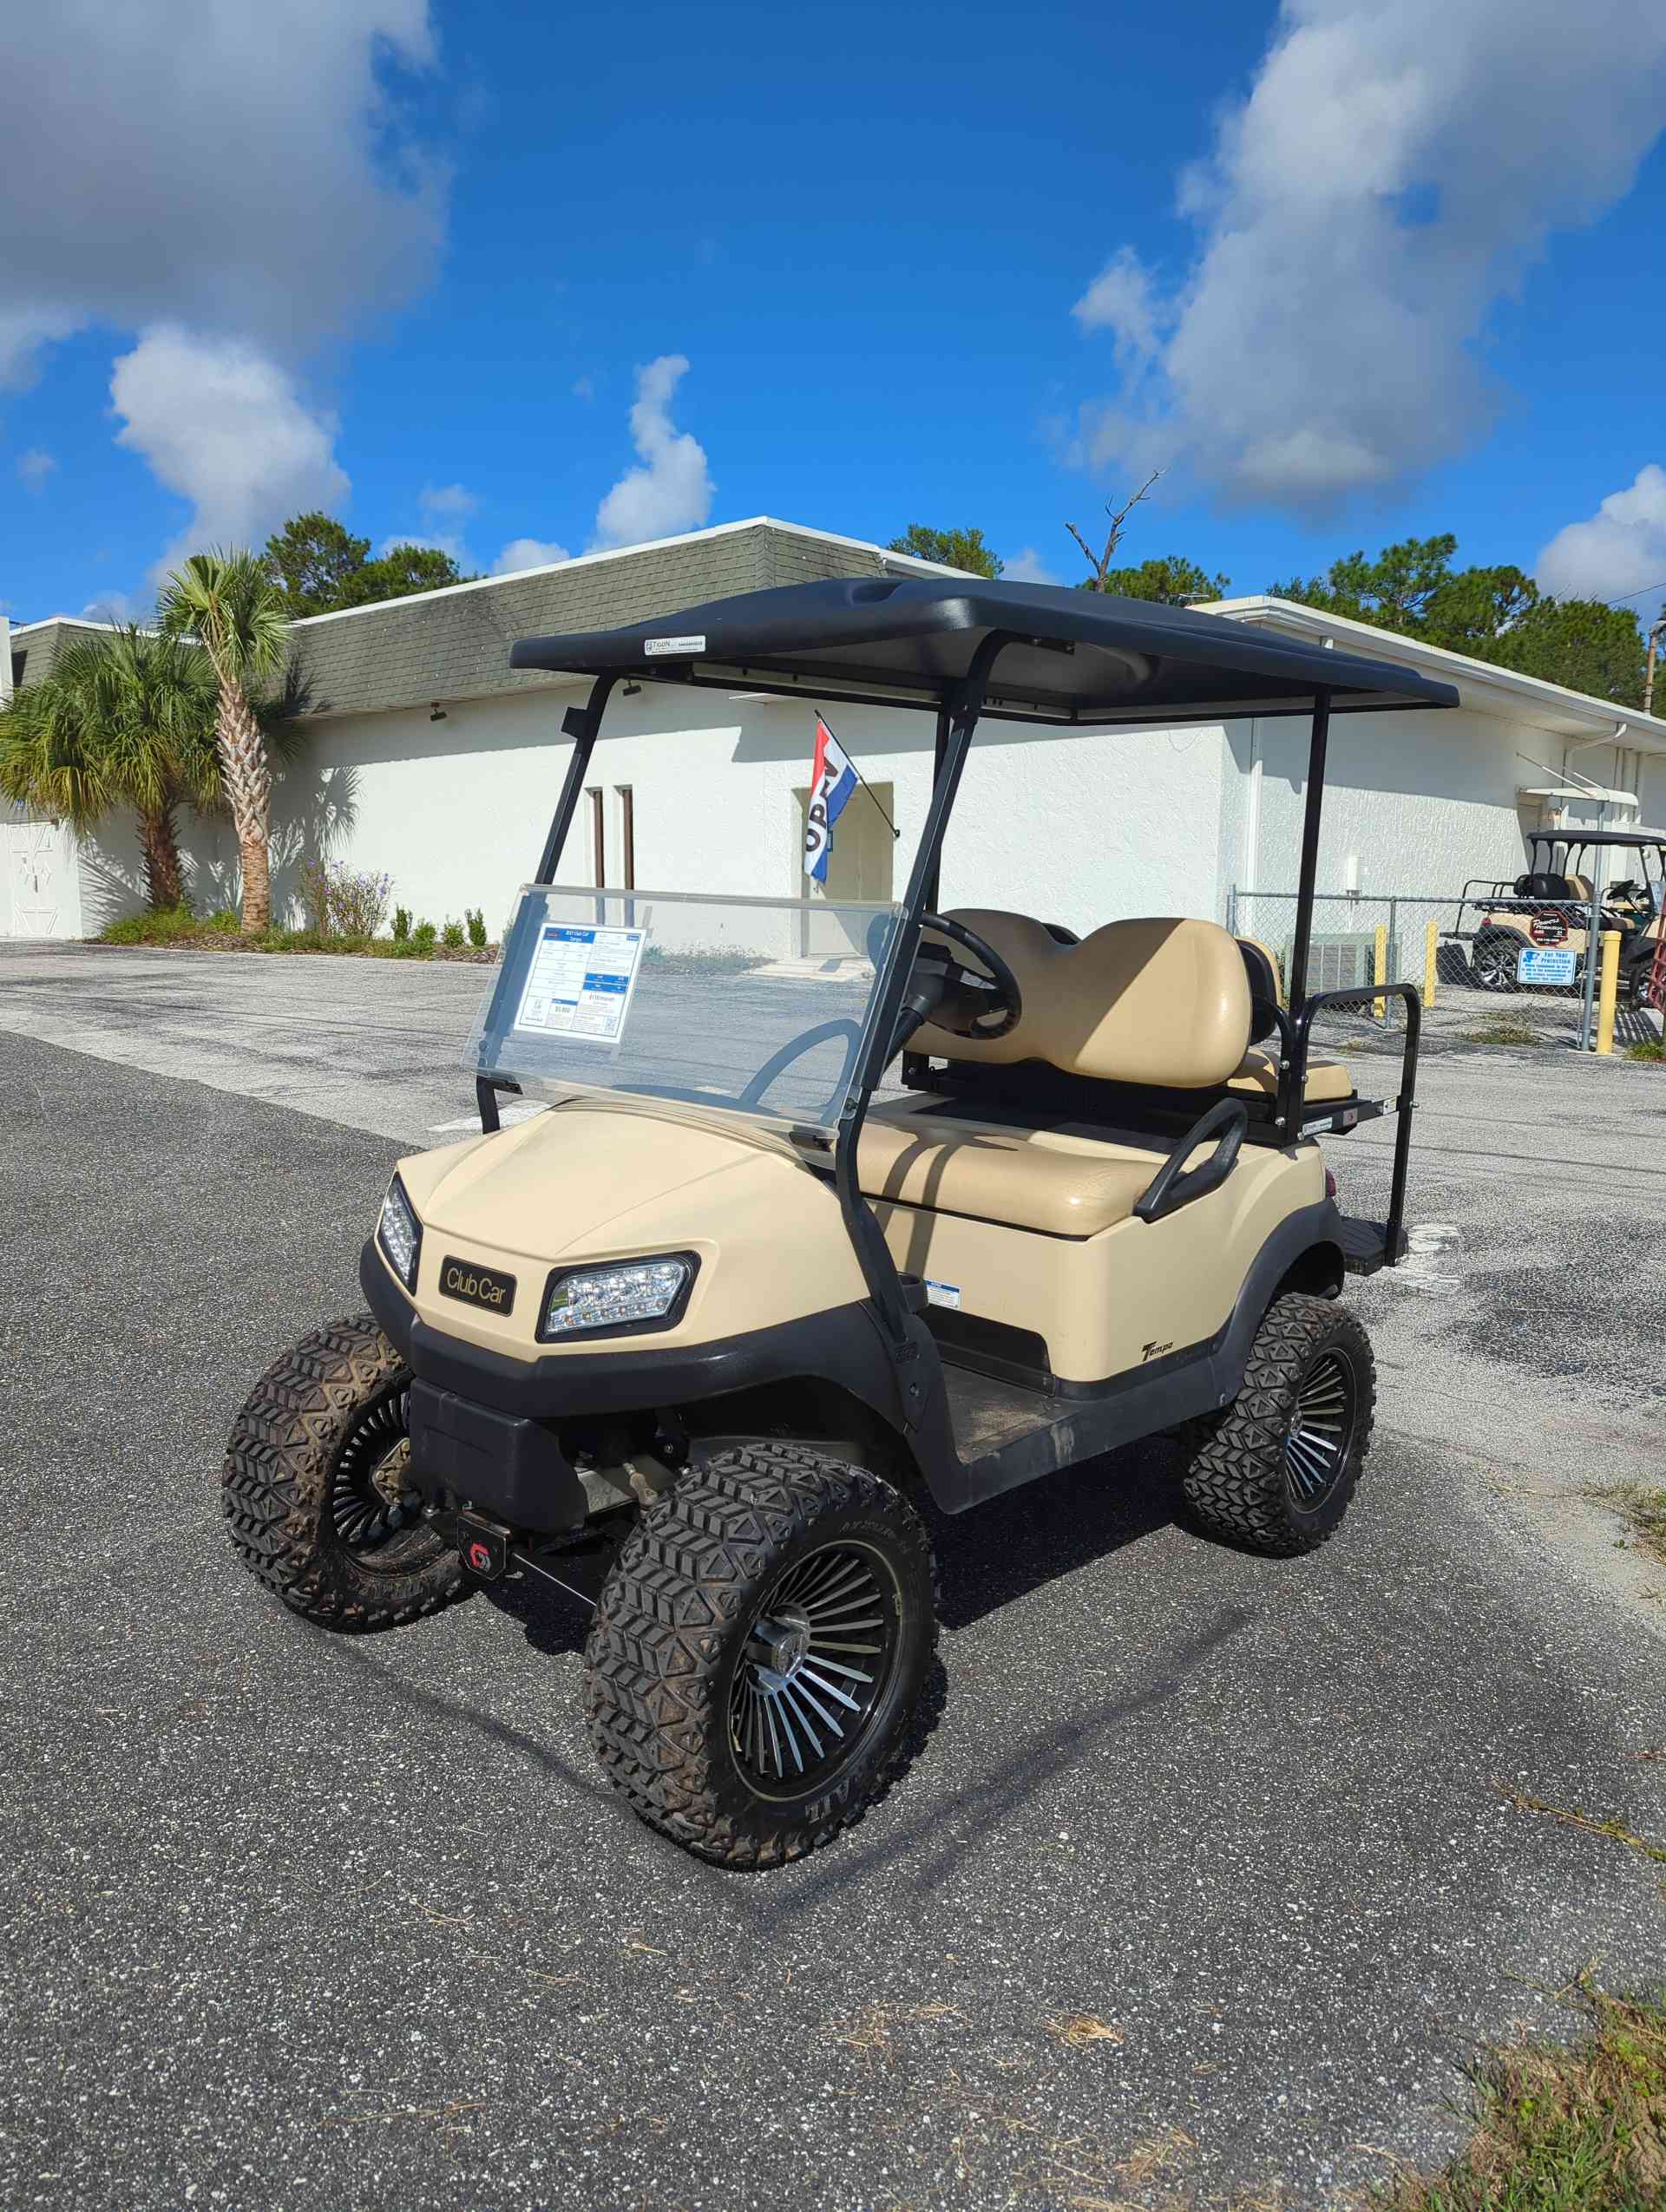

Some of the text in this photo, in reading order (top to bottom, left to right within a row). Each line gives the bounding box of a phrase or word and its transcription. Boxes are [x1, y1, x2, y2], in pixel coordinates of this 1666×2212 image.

[447, 1266, 507, 1304] Club Car
[1141, 1340, 1173, 1362] Tempo
